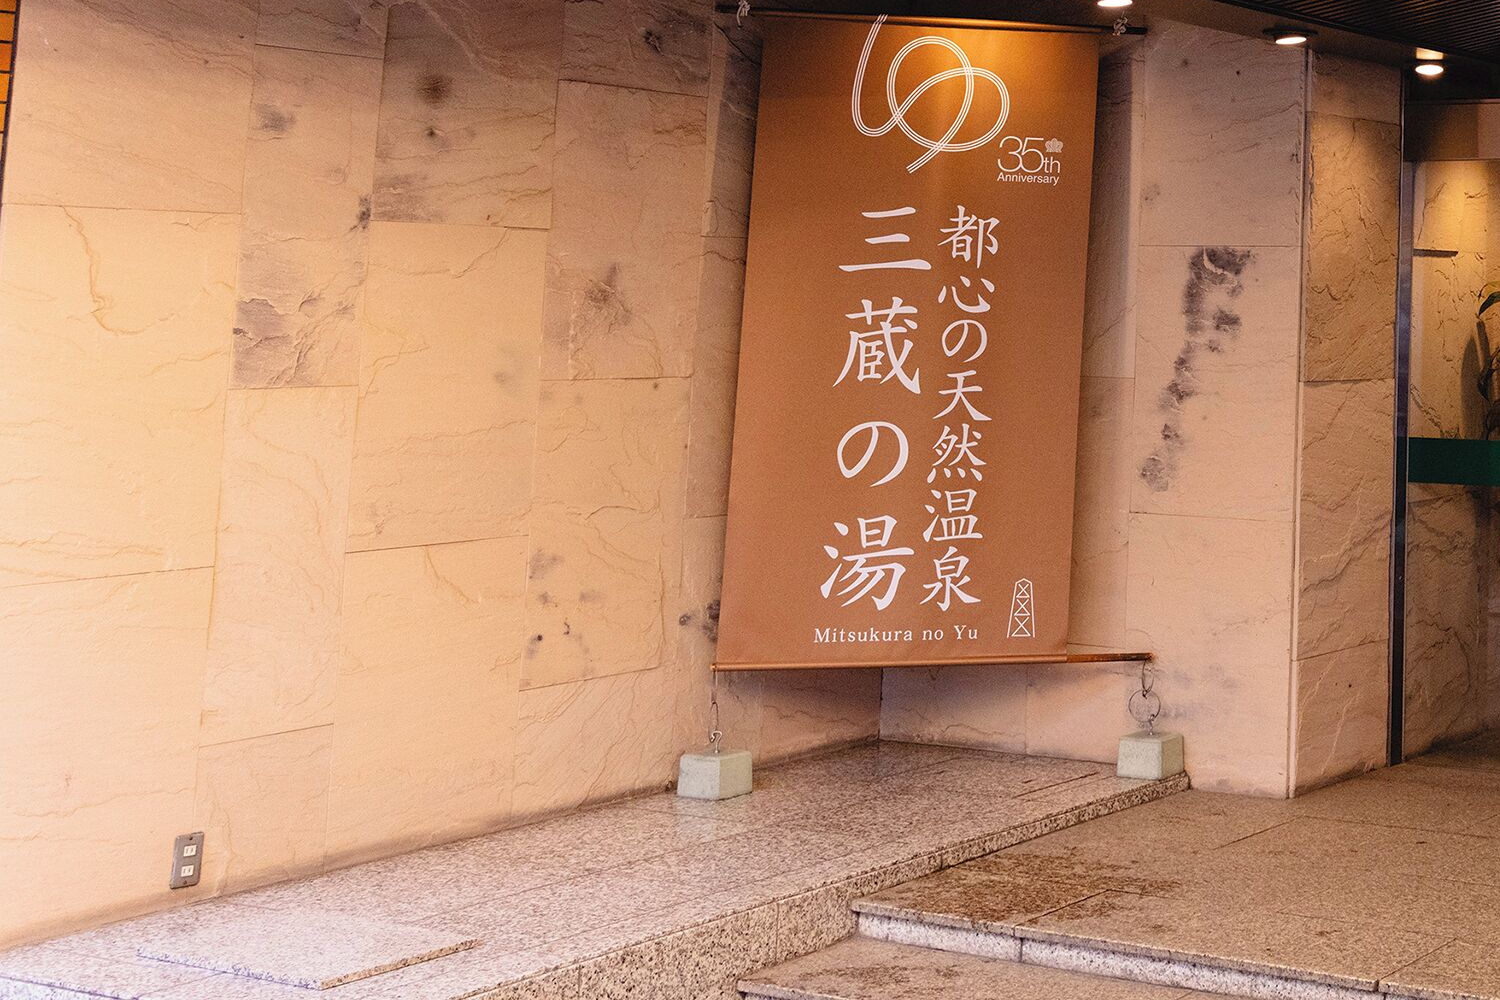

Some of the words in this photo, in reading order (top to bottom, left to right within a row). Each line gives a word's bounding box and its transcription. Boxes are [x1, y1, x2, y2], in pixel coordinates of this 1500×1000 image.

[997, 135, 1061, 174] 35th
[997, 171, 1060, 187] Anniversary
[818, 206, 933, 612] 三蔵の湯
[919, 204, 1001, 612] 都心の天然温泉
[814, 627, 913, 643] Mitsukura
[922, 629, 944, 641] no
[954, 624, 979, 641] Yu
